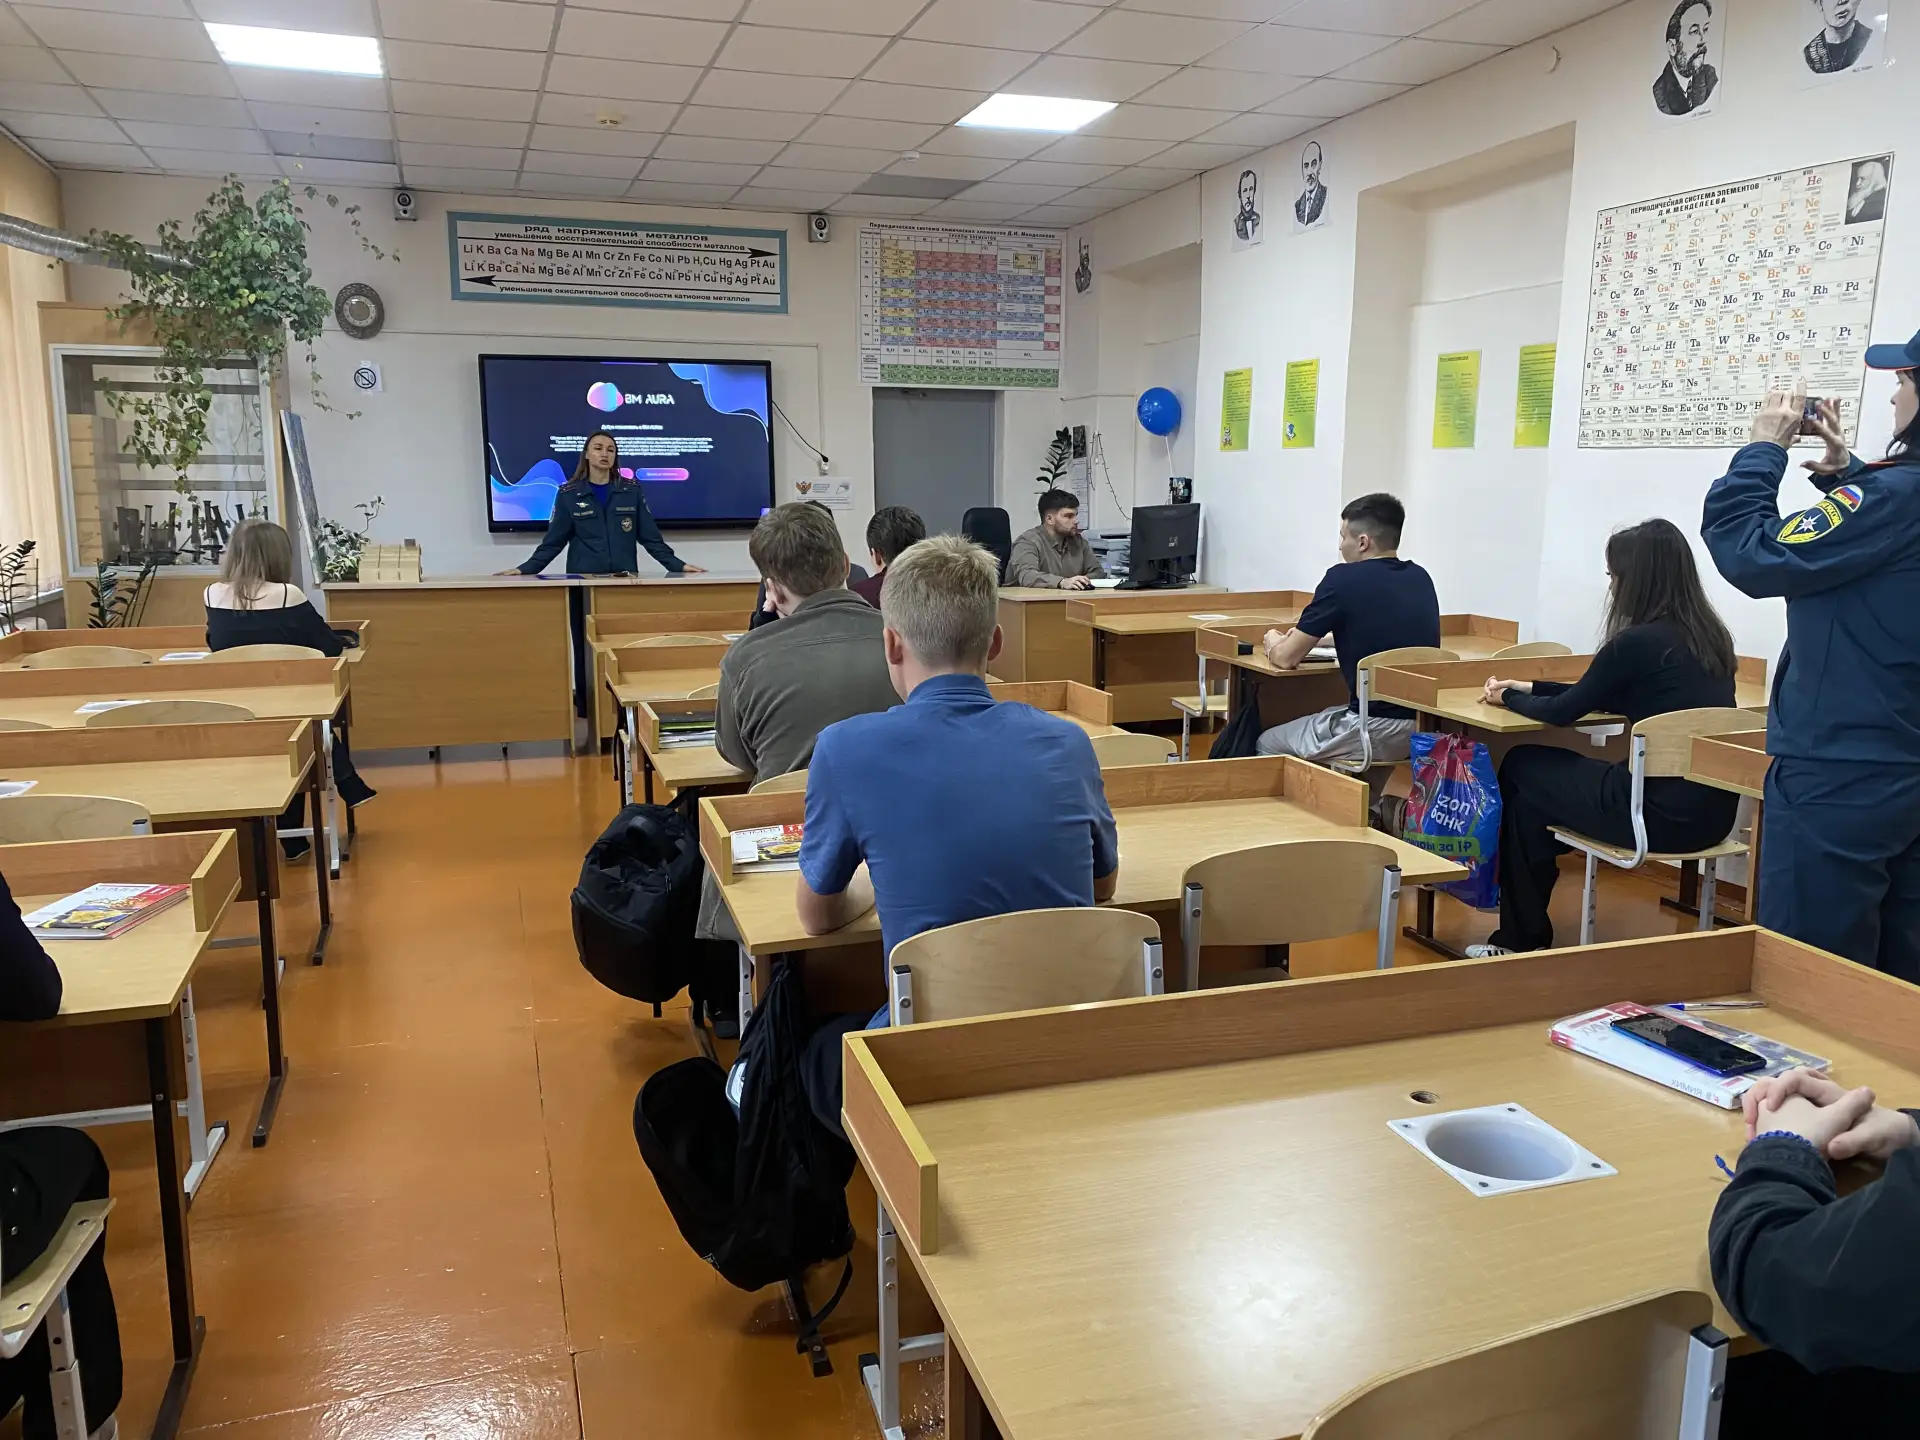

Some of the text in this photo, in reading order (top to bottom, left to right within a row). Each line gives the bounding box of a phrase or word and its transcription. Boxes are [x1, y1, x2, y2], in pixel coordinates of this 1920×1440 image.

[1604, 176, 1822, 226] H He
[1630, 183, 1760, 214] ПЕРИОДИЧЕСКАЯ СИСТЕМА ЭЛЕМЕНТОВ
[1673, 196, 1726, 213] МЕНДЕЛЕЕВА
[524, 225, 708, 241] ряд напряжений металлов
[1603, 236, 1612, 245] Li
[1626, 231, 1638, 241] Be
[1805, 197, 1820, 208] Ne
[494, 232, 552, 240] уменьшение
[554, 235, 643, 245] восстановительной
[646, 239, 702, 248] способности
[1601, 254, 1613, 263] Na
[1624, 250, 1638, 261] Mg
[1663, 243, 1673, 252] Al
[1688, 238, 1698, 248] Si
[1748, 229, 1756, 239] S
[1774, 225, 1785, 235] Cl
[1803, 220, 1817, 231] Ar
[463, 244, 473, 253] Li
[476, 245, 484, 254] K
[487, 245, 501, 255] Ba
[504, 246, 518, 256] Ca
[521, 247, 535, 257] Na
[537, 248, 553, 259] Mg
[556, 249, 569, 258] Be
[572, 249, 583, 259] Al
[585, 250, 600, 260] Mn
[603, 251, 615, 261] Cr
[617, 252, 630, 261] Zn
[633, 253, 646, 262] Fe
[648, 253, 662, 263] Co
[664, 254, 675, 263] Ni
[677, 255, 690, 264] Pb
[702, 256, 716, 266] Cu
[719, 257, 732, 268] Hg
[734, 258, 748, 269] Ag
[750, 259, 761, 268] Pt
[762, 259, 775, 269] Au
[1600, 236, 1865, 282] K Ca Sc Ti V Cr Mn Fe Co Ni
[554, 288, 618, 296] окислительной
[1610, 265, 1811, 300] Cu Zn Ga Ge As Se Br Kr
[1596, 281, 1859, 320] Rb Sr Y Zr Nb Mo Tc Ru Rh Pd
[1606, 328, 1618, 338] Ag
[1630, 325, 1640, 335] Cd
[1678, 320, 1690, 329] Sn
[1704, 317, 1716, 327] Sb
[1733, 314, 1745, 323] Te
[1790, 309, 1805, 319] Xe
[1593, 347, 1604, 356] Cs
[1616, 346, 1627, 354] Ba
[1665, 340, 1677, 350] Hf
[1689, 338, 1701, 347] Ta
[1719, 335, 1730, 345] W
[1747, 333, 1760, 343] Re
[1776, 331, 1791, 341] Os
[1807, 329, 1817, 339] Ir
[1839, 326, 1852, 336] Pt
[1603, 365, 1614, 374] Au
[1625, 363, 1638, 372] Hg
[1675, 359, 1686, 367] Pb
[1702, 357, 1712, 366] Bi
[1728, 355, 1740, 364] Po
[1757, 354, 1769, 363] At
[1784, 351, 1800, 361] Rn
[624, 394, 675, 405] BM AURA
[1438, 843, 1454, 852] за
